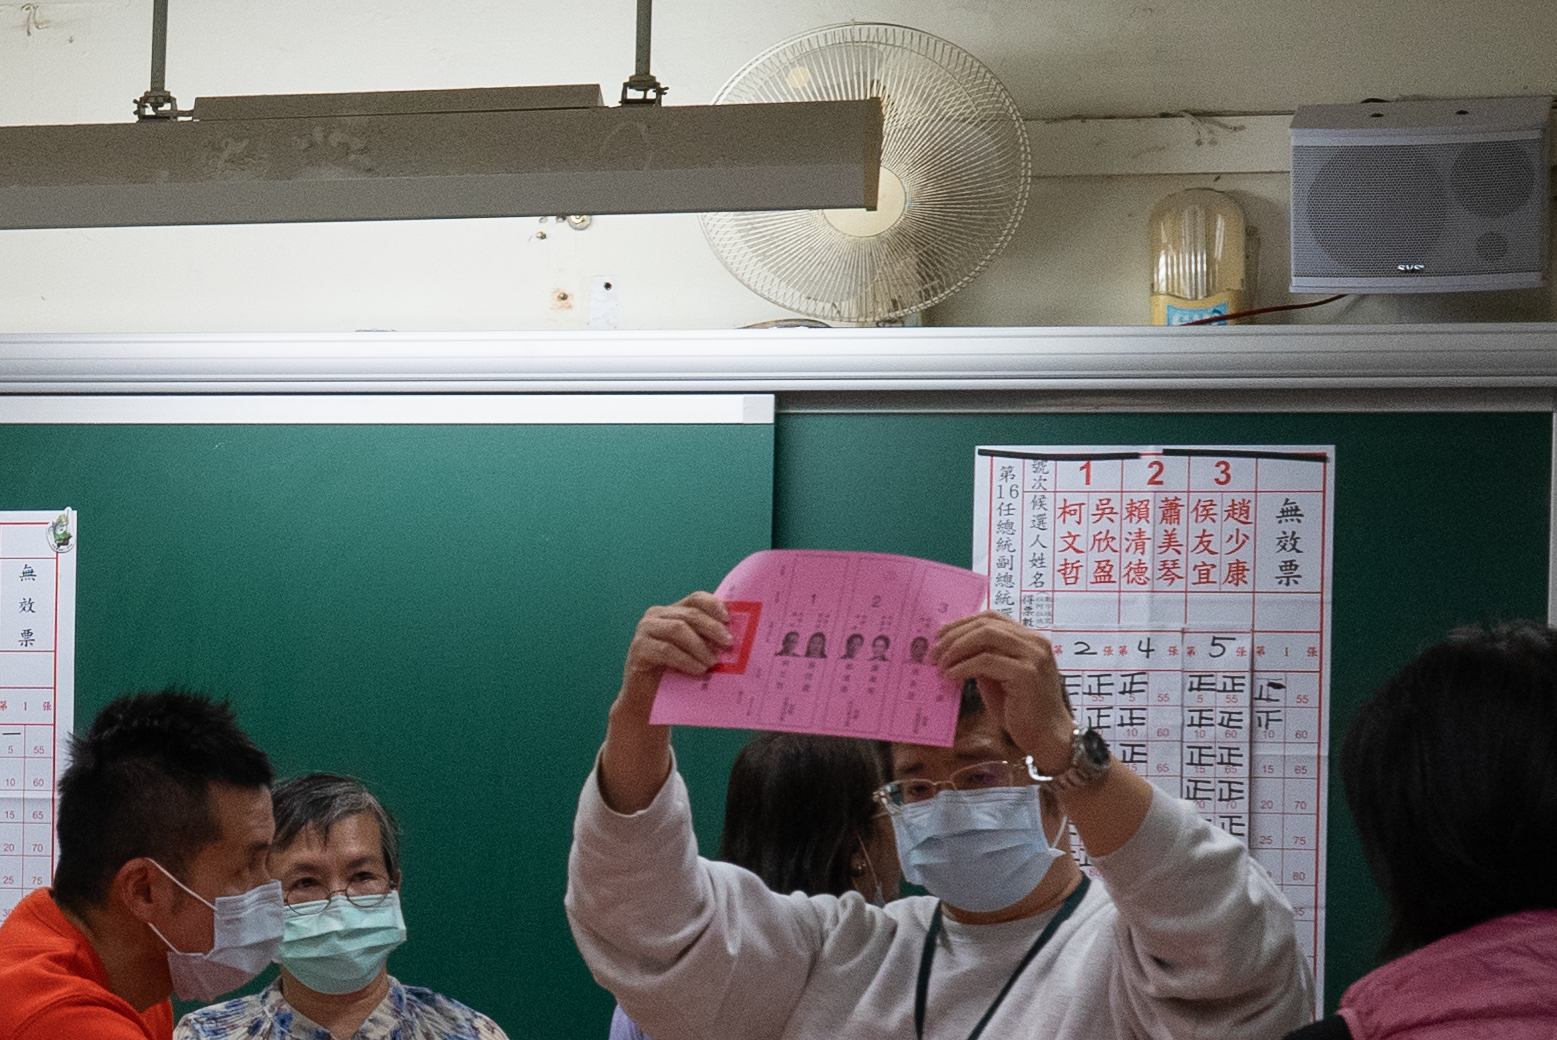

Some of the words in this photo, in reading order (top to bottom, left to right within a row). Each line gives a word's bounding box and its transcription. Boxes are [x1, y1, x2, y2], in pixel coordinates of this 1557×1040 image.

[1079, 460, 1092, 485] 1
[1147, 461, 1164, 485] 2
[1214, 460, 1231, 485] 3
[1028, 495, 1049, 588] 候選人姓名
[1057, 498, 1085, 585] 柯文哲
[1089, 499, 1119, 584] 吳欣盈
[1122, 498, 1152, 585] 賴清德
[1156, 496, 1184, 585] 蕭美琴
[1191, 499, 1218, 584] 侯友宜
[1222, 498, 1254, 586] 趙少康
[1275, 499, 1305, 585] 無效票
[18, 564, 37, 646] 無效票
[1074, 641, 1097, 655] 2
[1138, 637, 1155, 659] 4
[1209, 636, 1236, 658] 5
[1296, 694, 1309, 704] 55
[1262, 727, 1275, 738] 10
[1295, 730, 1308, 739] 60
[1262, 765, 1274, 774] 15
[1294, 765, 1307, 774] 65
[1258, 798, 1273, 810] 20
[1294, 801, 1307, 810] 70
[1257, 833, 1273, 847] 25
[1293, 836, 1306, 845] 75
